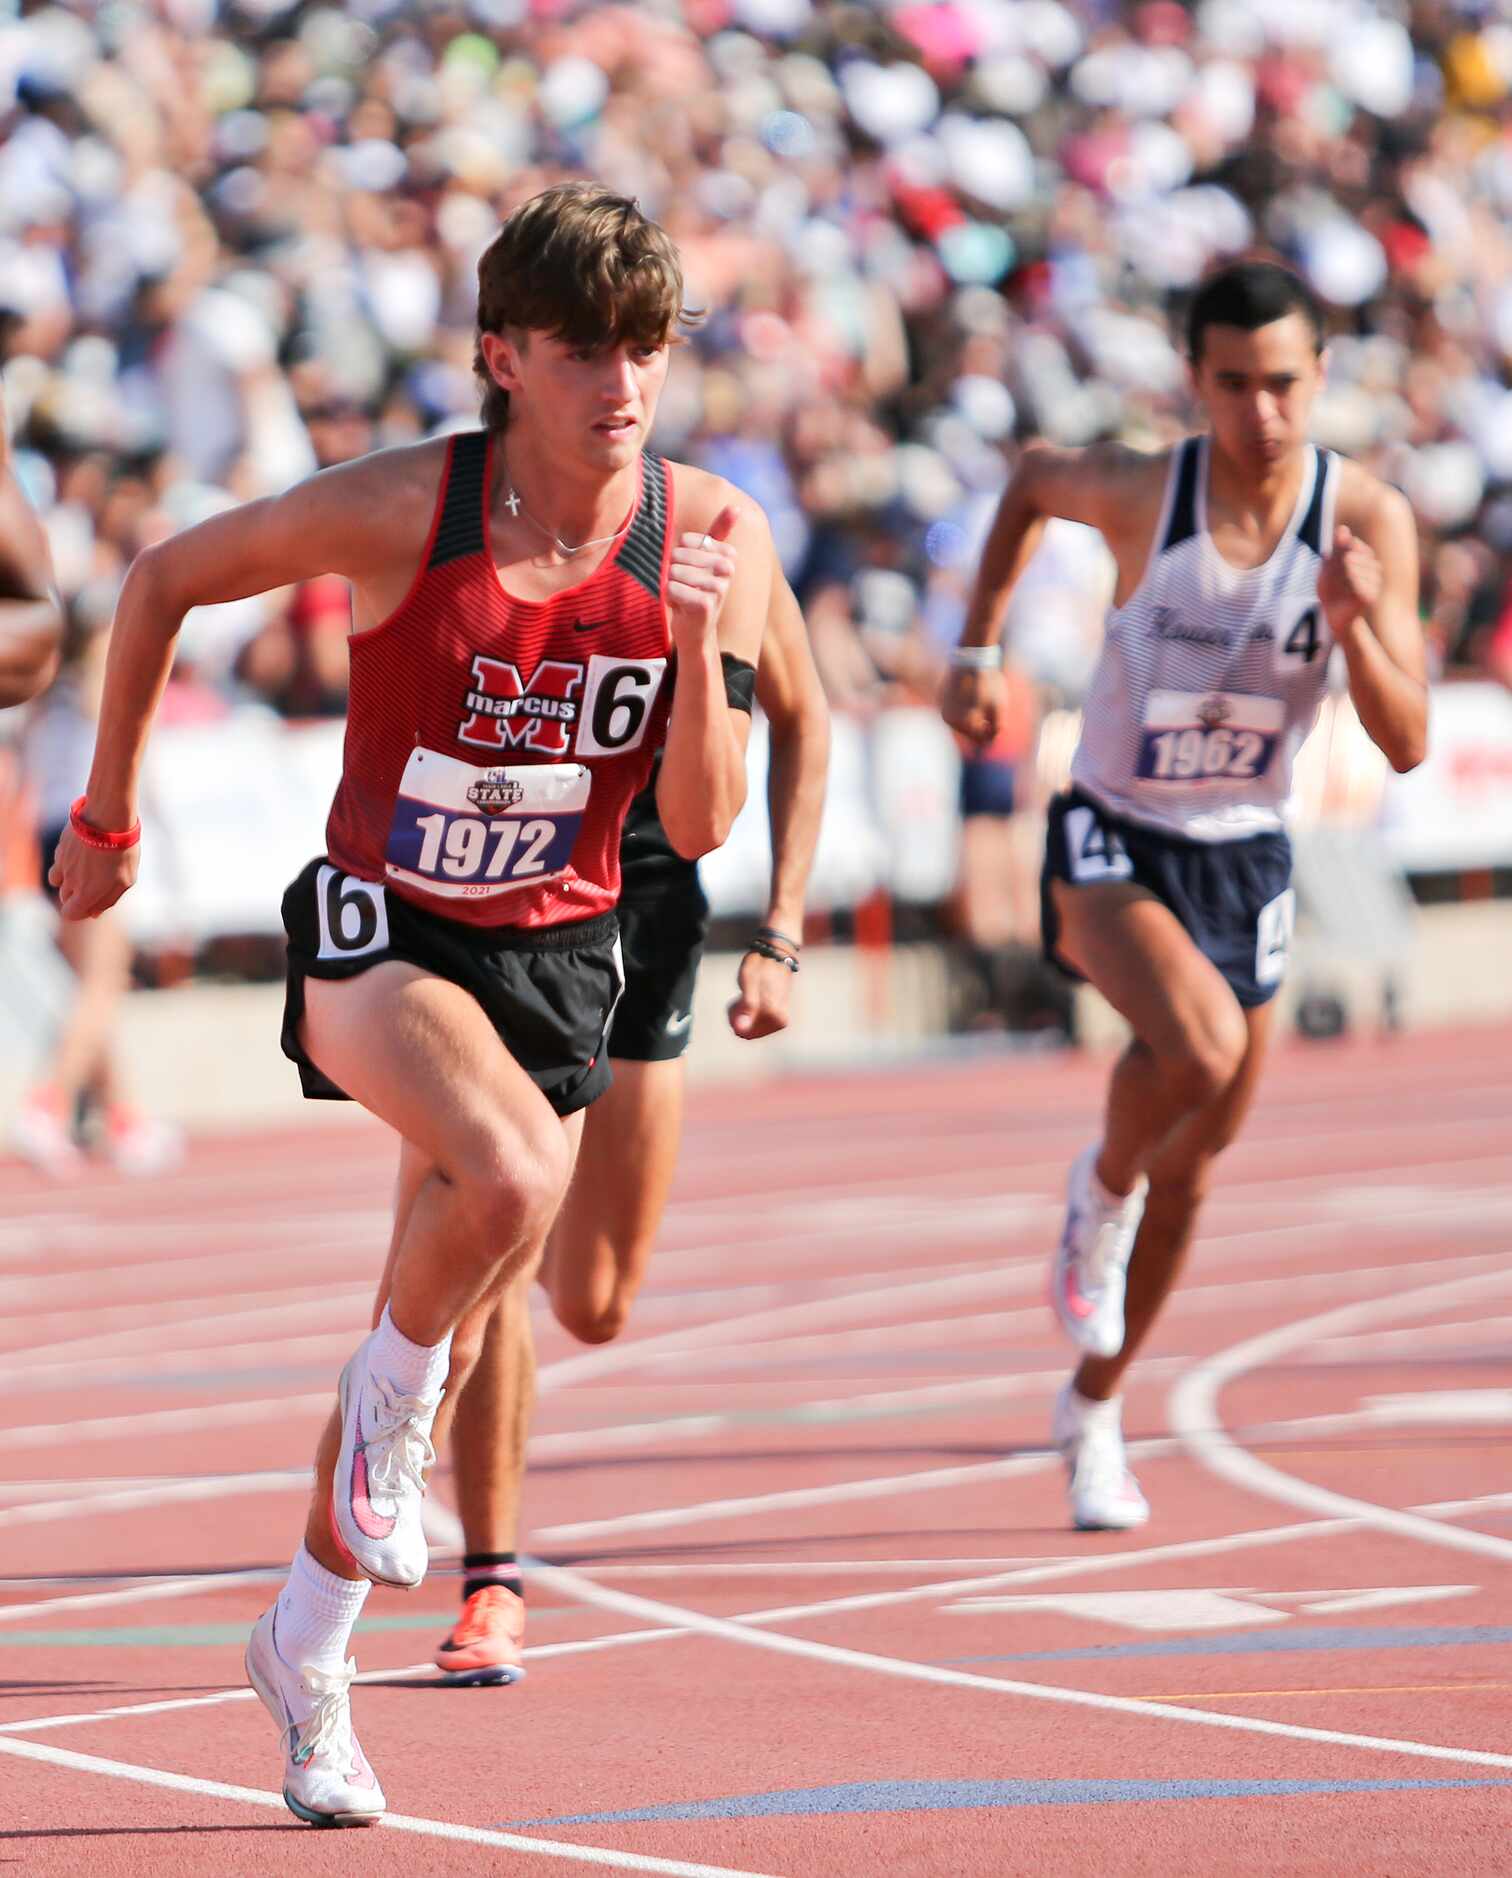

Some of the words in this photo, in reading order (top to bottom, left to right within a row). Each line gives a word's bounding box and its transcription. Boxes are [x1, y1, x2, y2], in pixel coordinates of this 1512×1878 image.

[1284, 606, 1322, 663] 4
[466, 691, 576, 719] marcus
[592, 665, 651, 749] 6
[1152, 729, 1264, 776] 1962
[468, 787, 523, 800] STATE
[416, 813, 556, 878] 1972
[327, 871, 378, 951] 6
[462, 886, 490, 896] 2021
